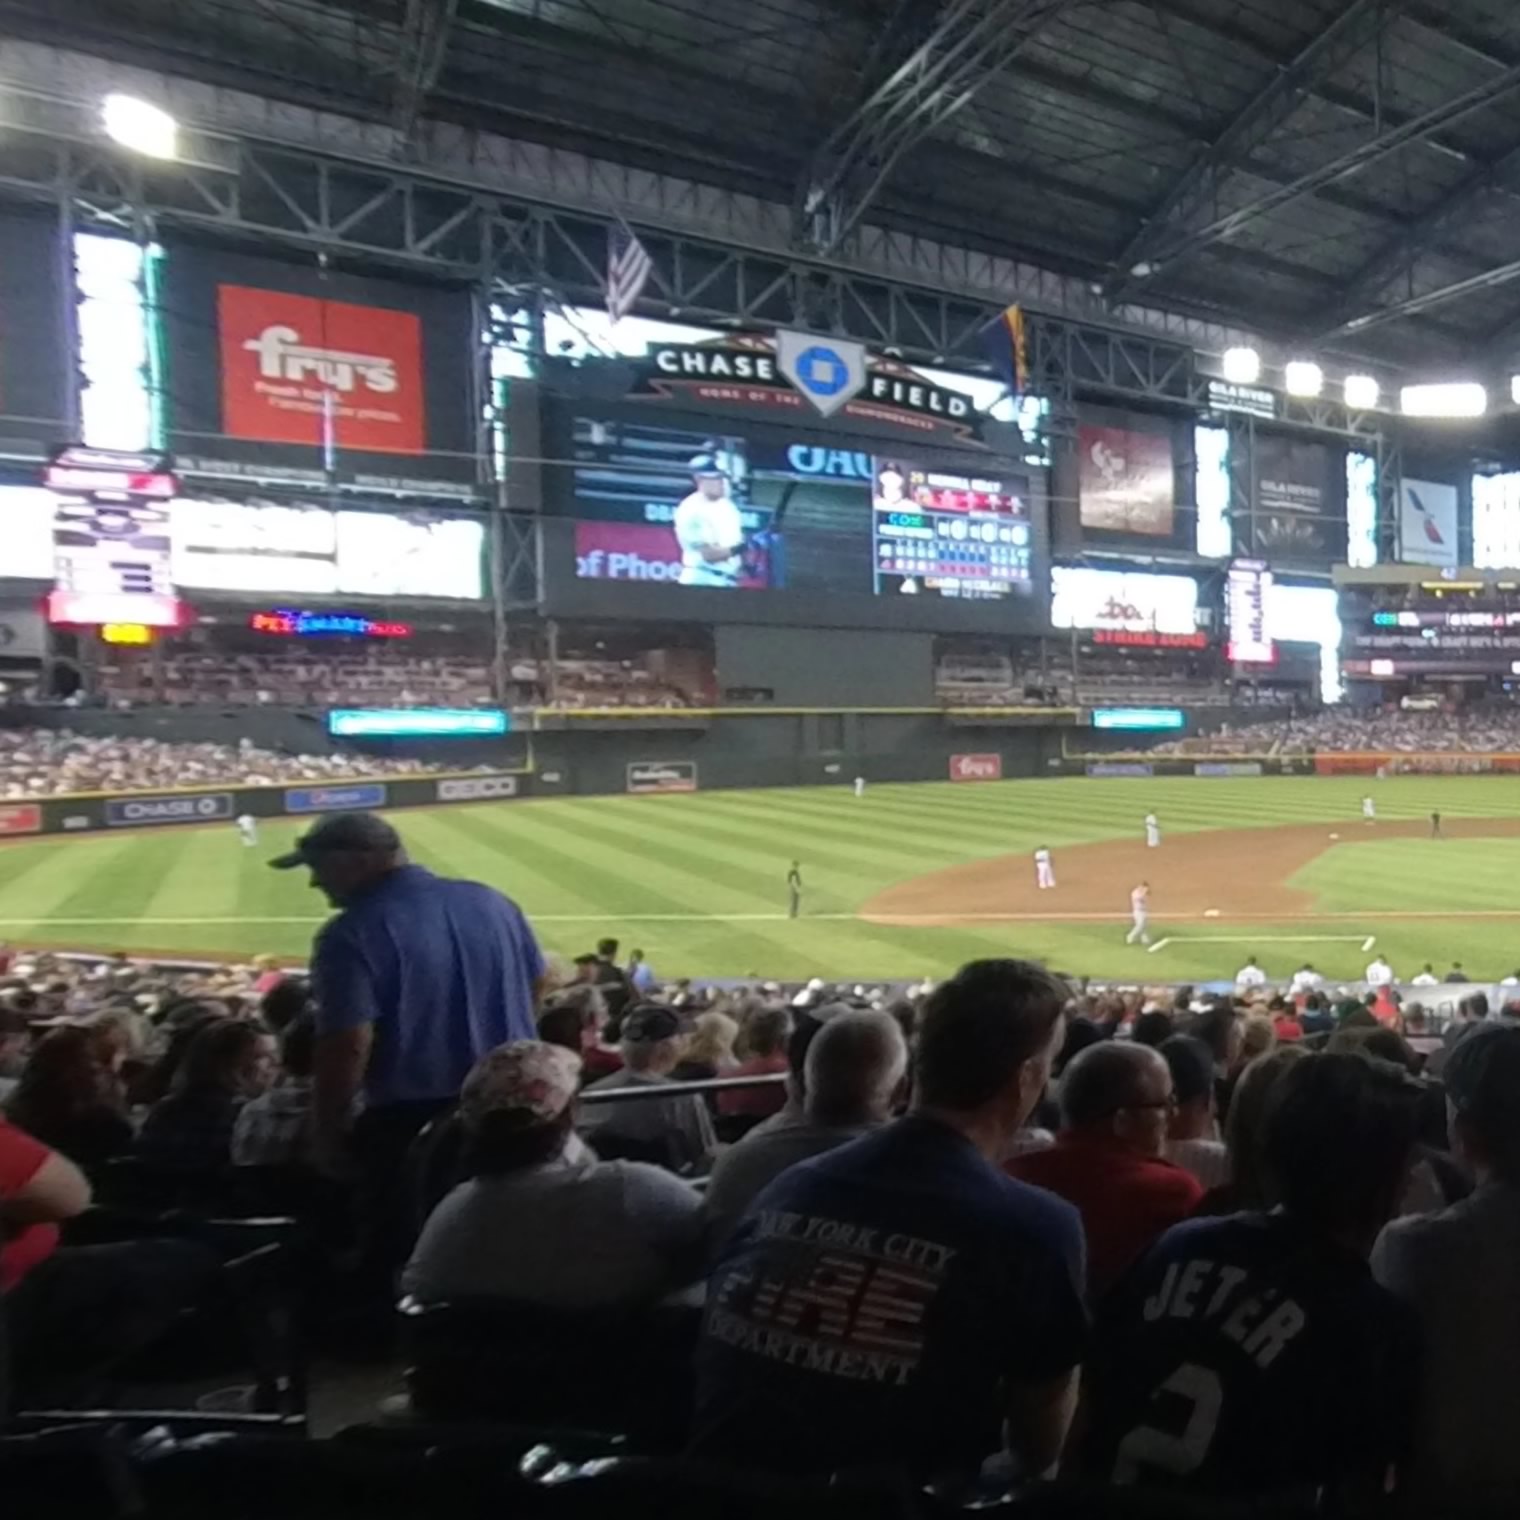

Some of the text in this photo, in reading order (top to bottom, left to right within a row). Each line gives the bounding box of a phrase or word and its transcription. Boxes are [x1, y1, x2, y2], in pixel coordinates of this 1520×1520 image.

[242, 325, 397, 391] fry's
[657, 350, 968, 416] CHASE FIELD
[700, 387, 800, 405] HOME OF THE
[846, 404, 934, 431] DIAMONDBACKS
[1208, 380, 1236, 396] GILA
[1237, 386, 1275, 403] RIVER
[124, 801, 194, 818] CHASE
[803, 1217, 879, 1251] YORK
[884, 1233, 957, 1271] CITY
[717, 1257, 939, 1351] FIRE
[1143, 1259, 1305, 1368] JETER
[708, 1308, 920, 1386] DEPARTMENT
[1111, 1360, 1224, 1485] 2
